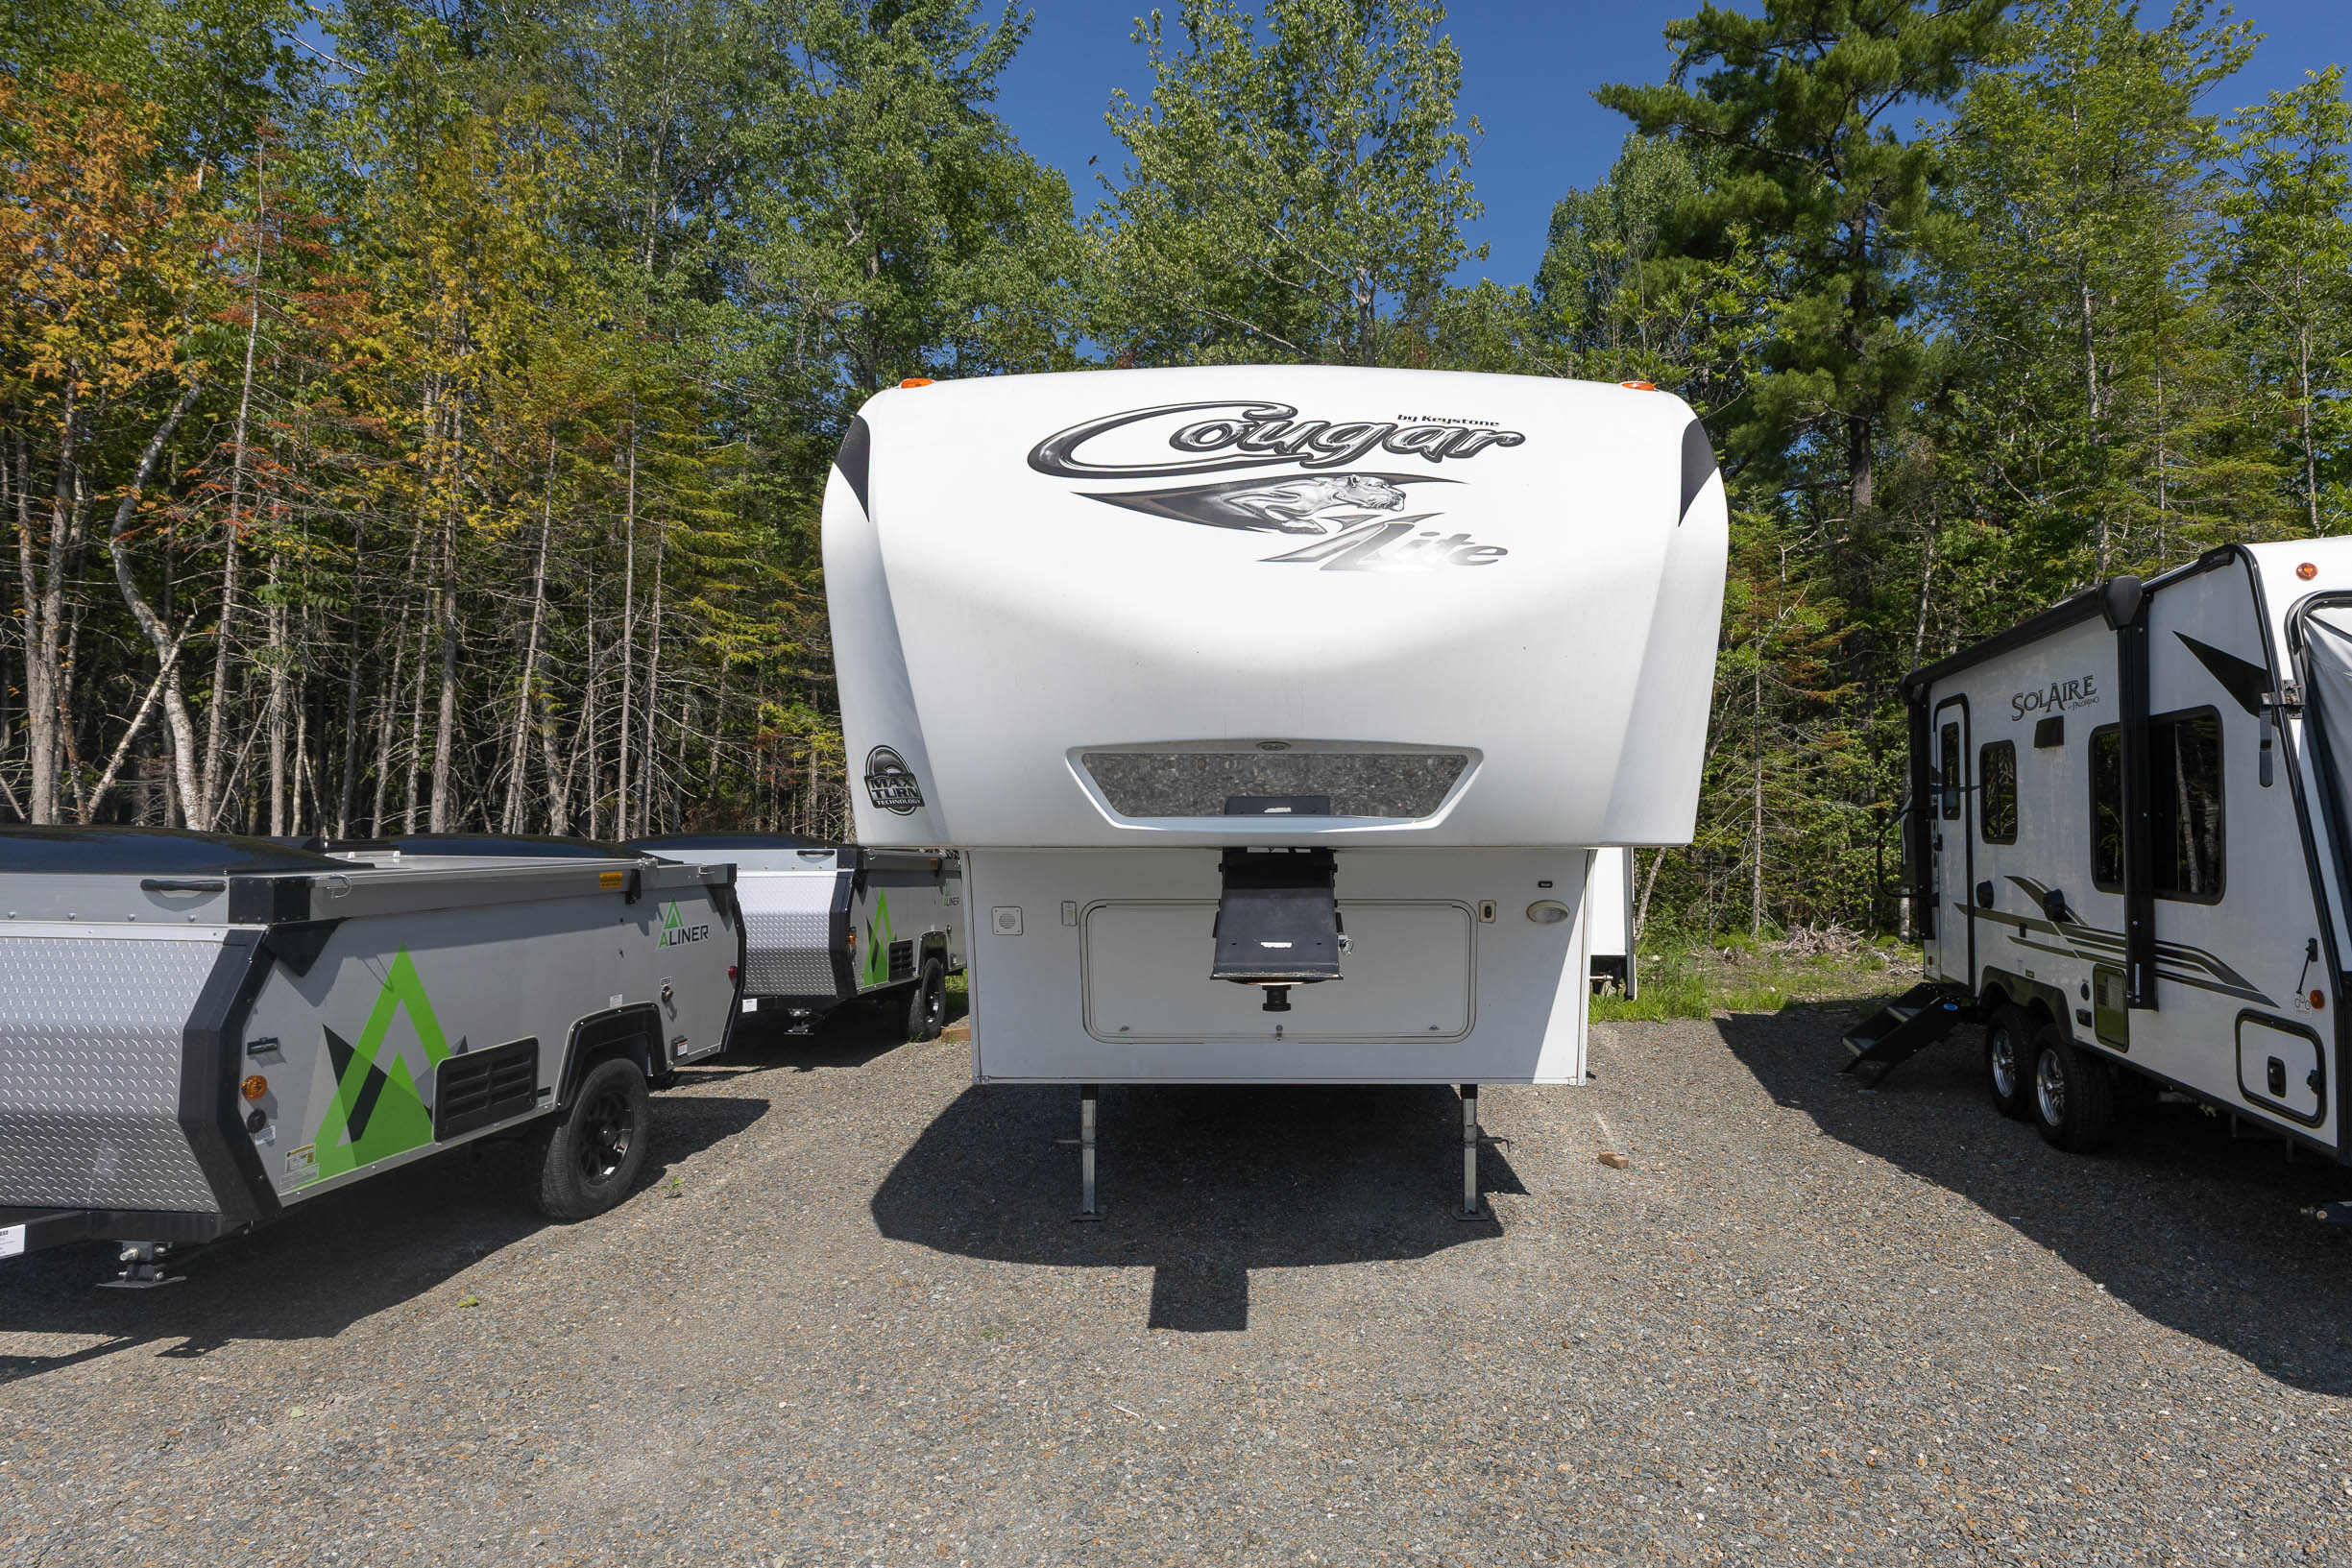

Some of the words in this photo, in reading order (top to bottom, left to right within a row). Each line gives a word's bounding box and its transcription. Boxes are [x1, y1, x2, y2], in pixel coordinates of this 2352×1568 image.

[1397, 414, 1418, 422] by
[1421, 415, 1500, 426] Keystone
[1027, 400, 1525, 479] Cougar
[2011, 674, 2097, 722] SOLAIRE
[870, 775, 915, 789] MAX
[871, 787, 919, 799] TURN
[657, 925, 709, 949] ALINER
